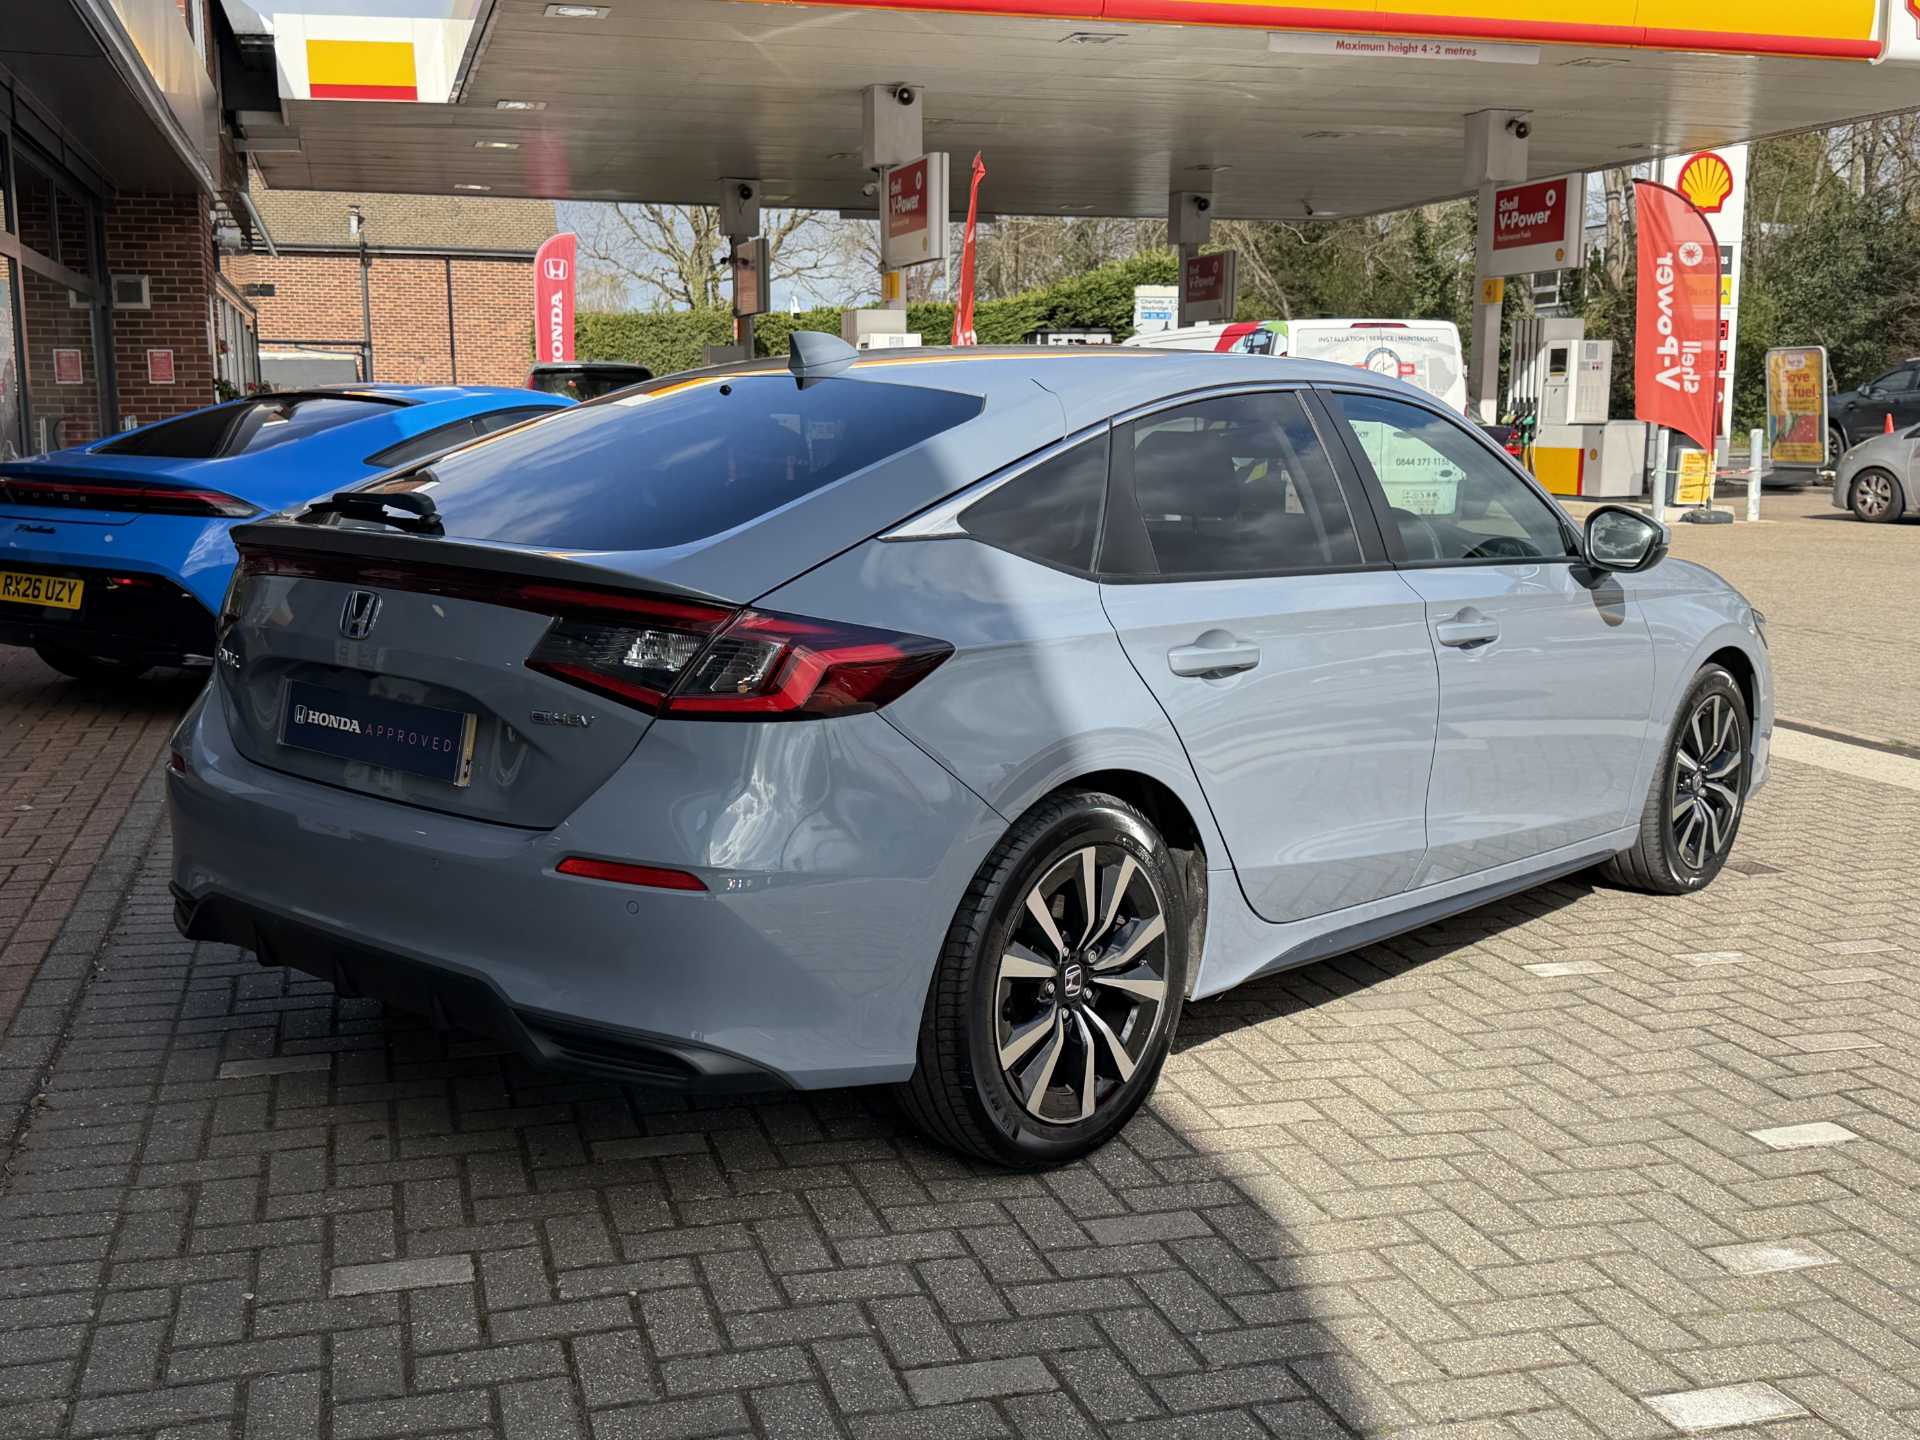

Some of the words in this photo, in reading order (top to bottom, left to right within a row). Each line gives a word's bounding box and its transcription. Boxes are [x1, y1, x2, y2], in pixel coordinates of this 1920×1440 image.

[1335, 40, 1385, 51] Maximum
[1387, 41, 1418, 55] height
[1444, 47, 1478, 56] metres
[1499, 195, 1519, 212] Shell
[1498, 209, 1551, 231] V-Power
[550, 289, 564, 362] ONDA
[1318, 335, 1365, 343] INSTALLATION
[1399, 335, 1439, 343] MAINTENANCE
[1793, 384, 1816, 398] fuel
[2, 574, 42, 600] RX26
[44, 579, 77, 603] UZY
[307, 709, 361, 734] HONDA
[365, 723, 452, 752] APPROVED
